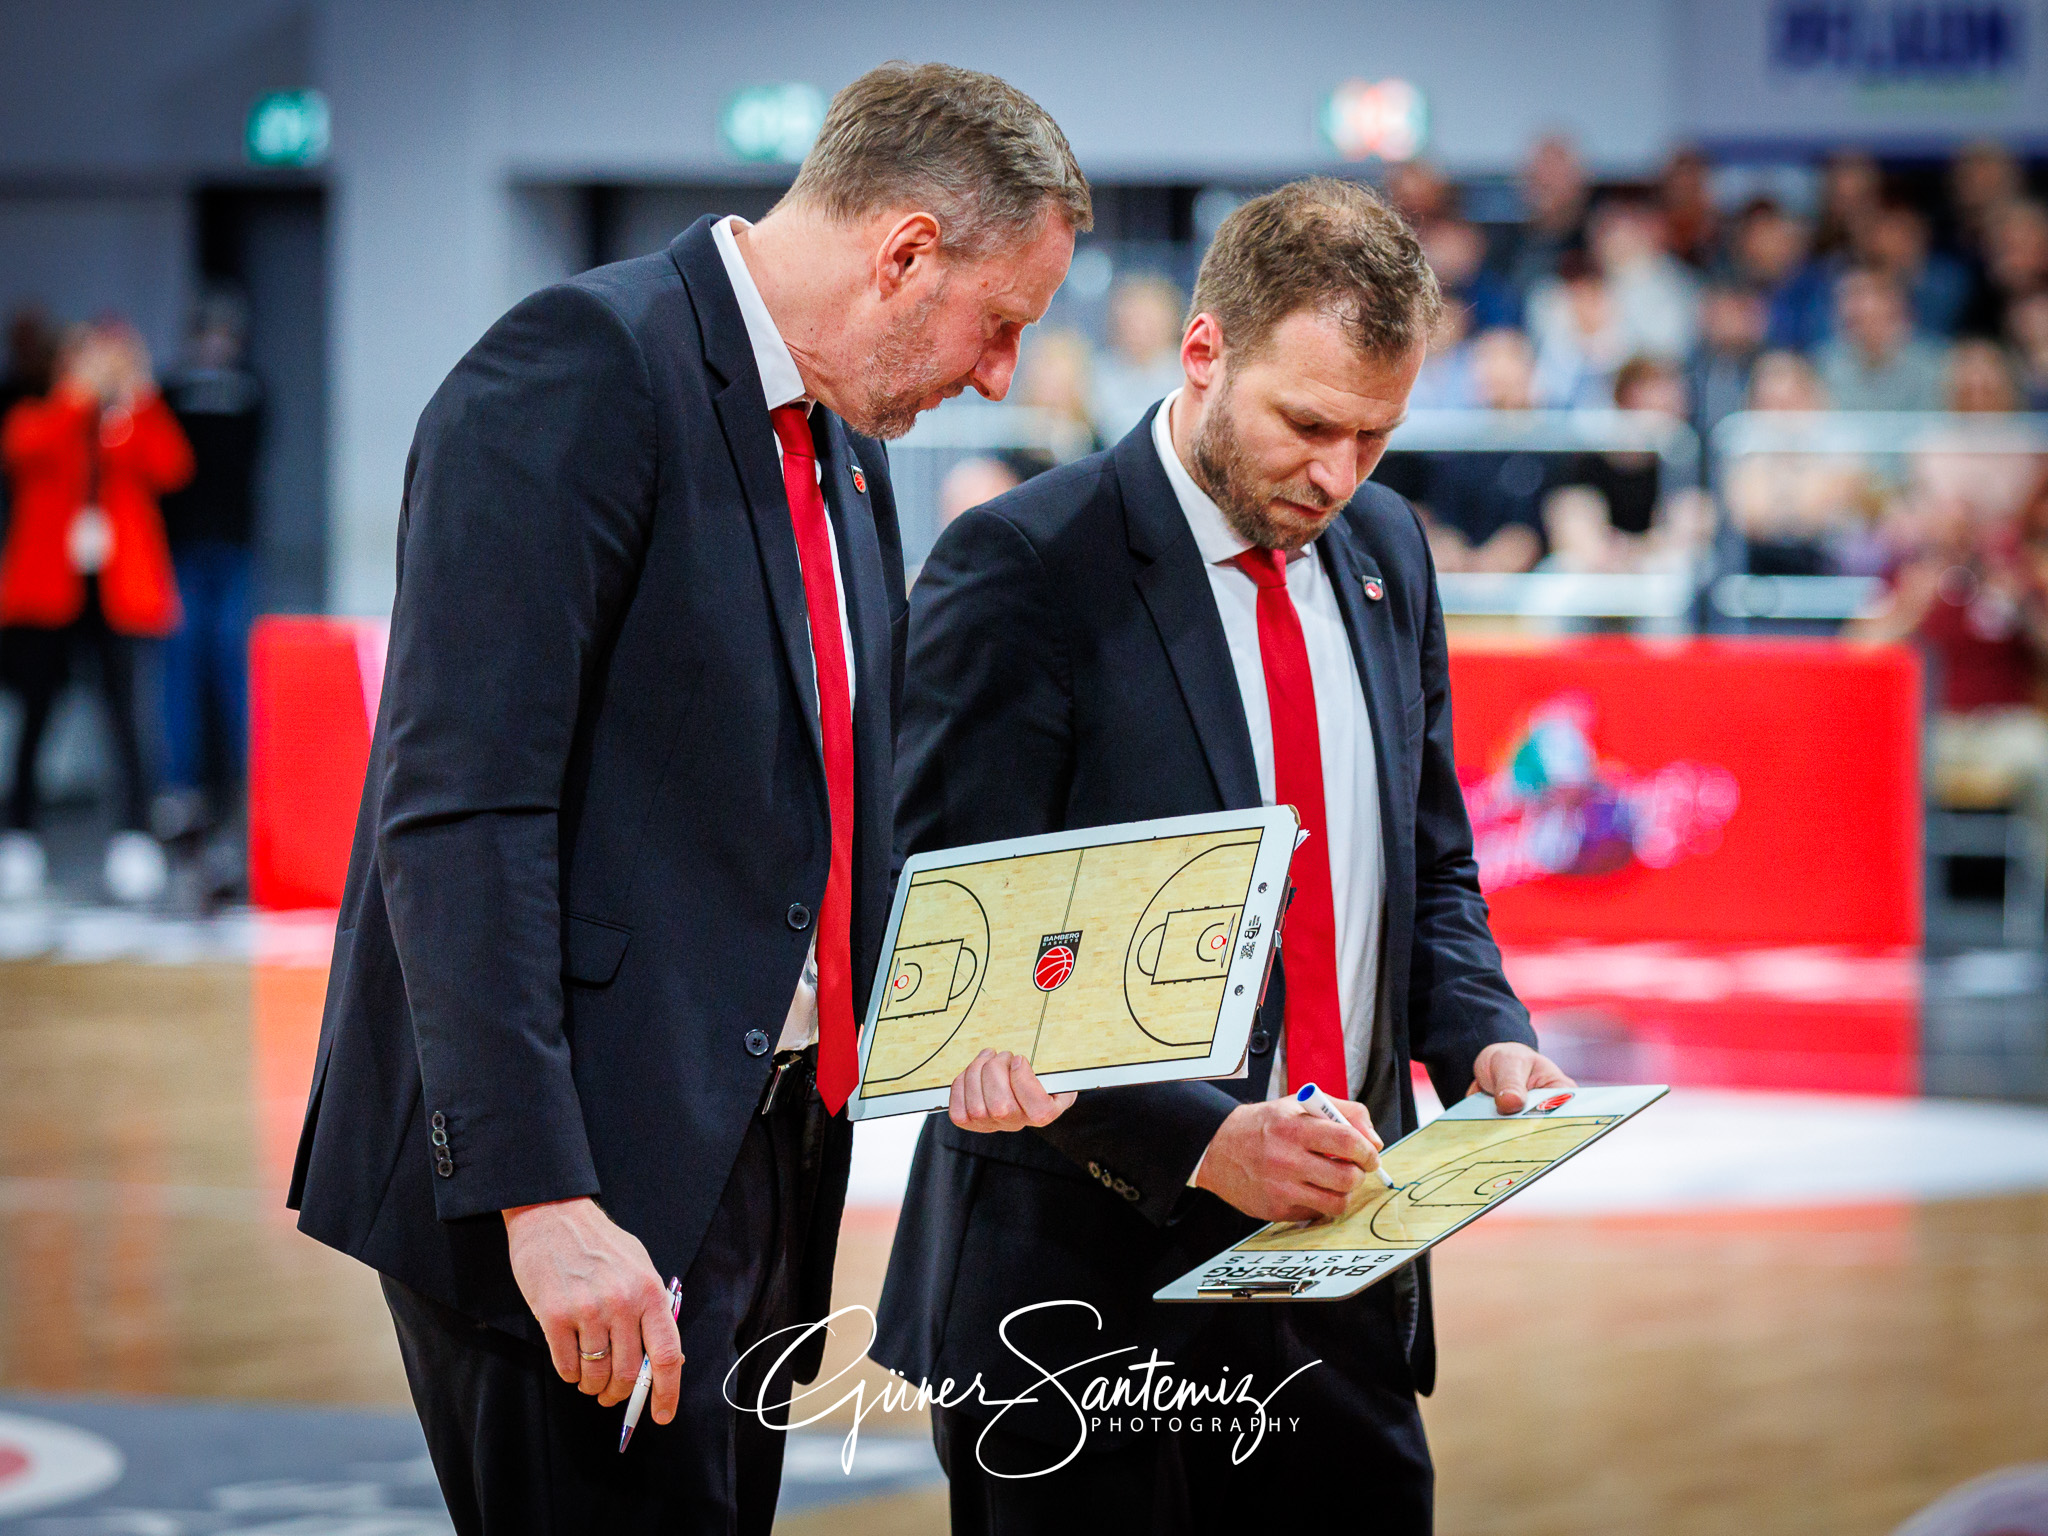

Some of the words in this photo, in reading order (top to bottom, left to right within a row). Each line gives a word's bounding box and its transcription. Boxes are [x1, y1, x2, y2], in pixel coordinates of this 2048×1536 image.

[1043, 932, 1080, 942] BAMBERG
[1042, 938, 1079, 947] BASKETS
[1225, 1254, 1395, 1264] BASKETS
[1203, 1265, 1377, 1278] BAMBERG
